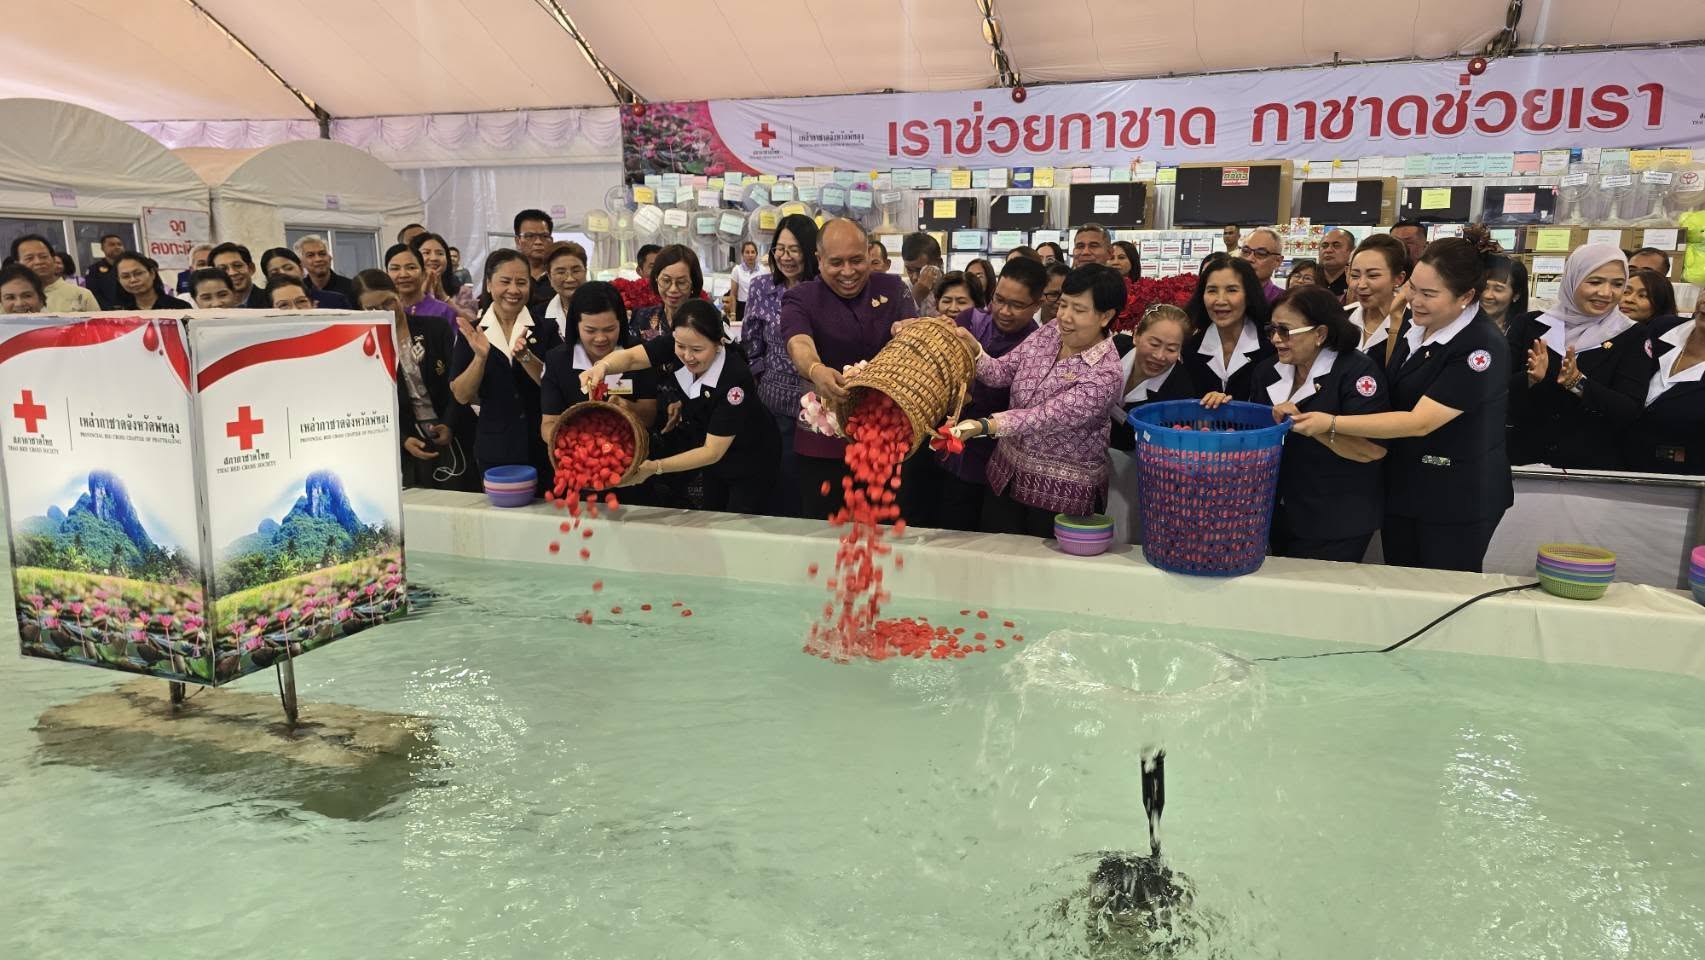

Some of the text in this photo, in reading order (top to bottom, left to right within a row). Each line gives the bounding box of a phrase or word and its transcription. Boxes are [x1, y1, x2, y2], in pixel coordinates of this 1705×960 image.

[888, 73, 1664, 156] เราช่วยกาชาด กาชาดช่วยเรา
[79, 411, 181, 439] เหล่ากาชาดจังหวัดพัทลุง
[299, 409, 389, 433] เหล่ากาชาดจังหวัดพัทลุง
[223, 448, 270, 465] สภากาชาดไทย
